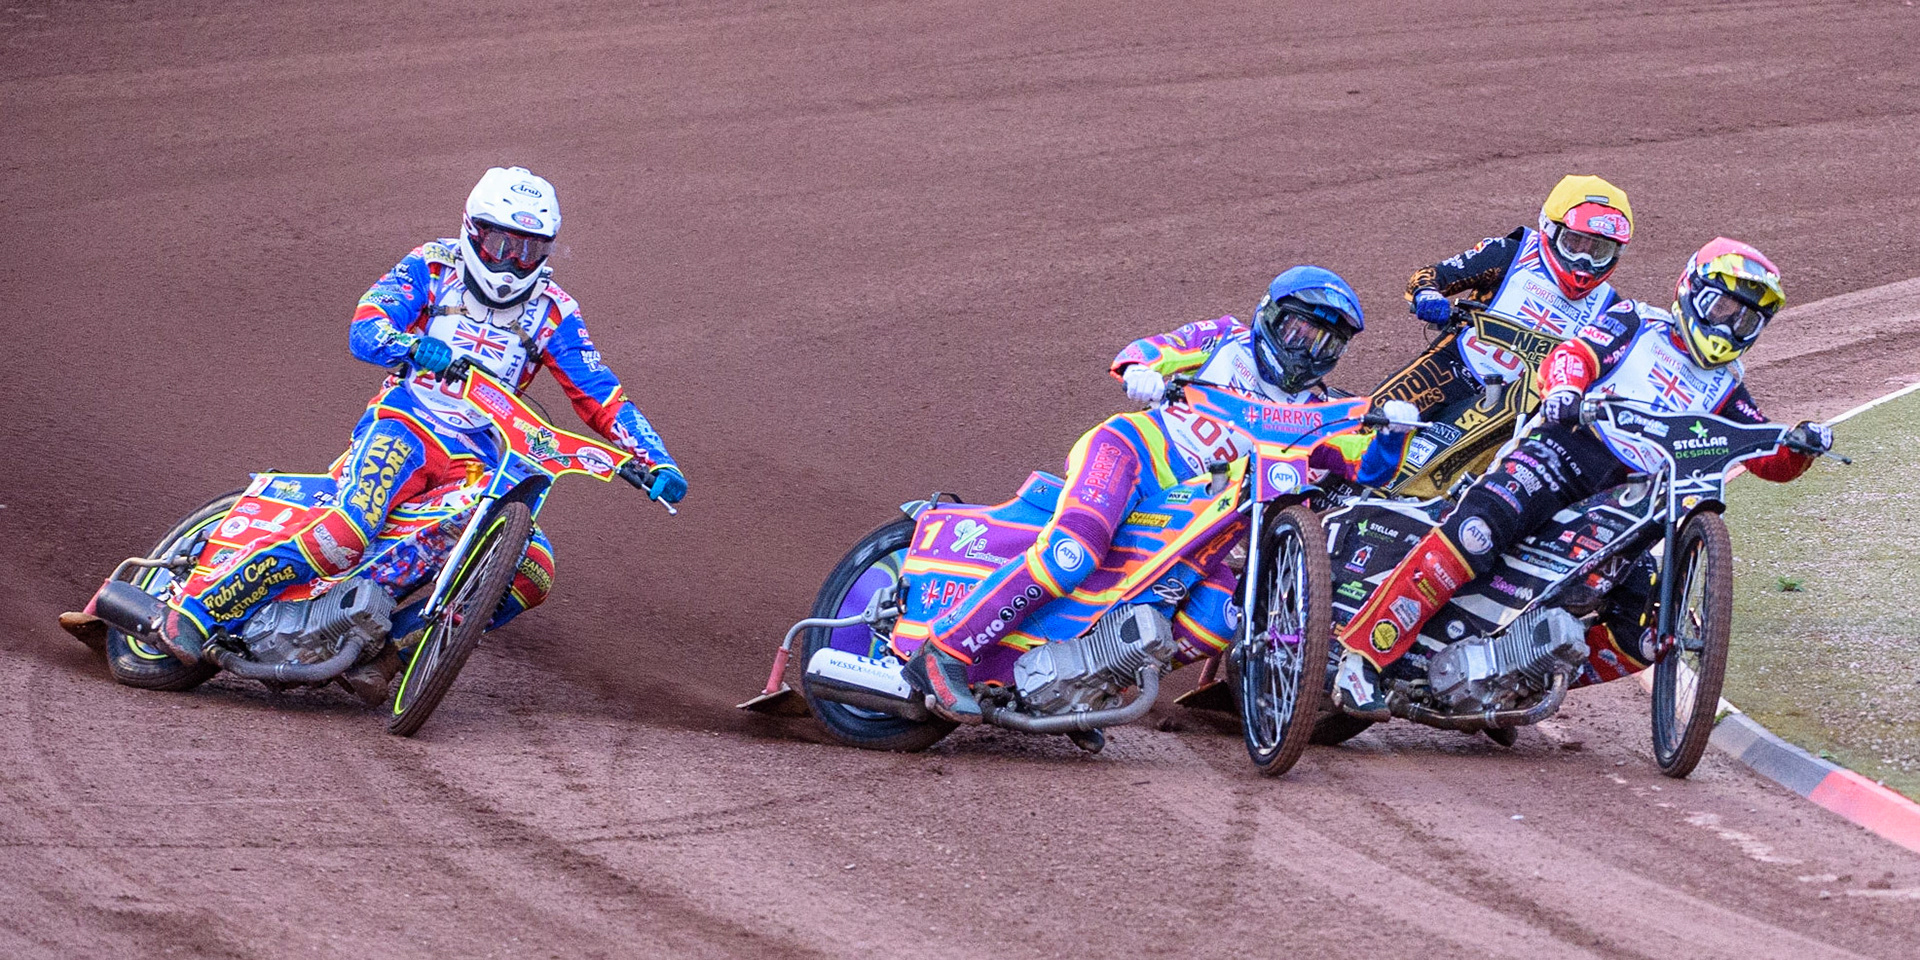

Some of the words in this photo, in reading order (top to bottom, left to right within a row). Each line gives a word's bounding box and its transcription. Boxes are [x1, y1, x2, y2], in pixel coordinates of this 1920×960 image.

[1525, 280, 1556, 304] SPORTS
[1555, 296, 1580, 321] INSURE
[1573, 292, 1599, 335] FINAL
[1234, 357, 1258, 387] SPORTS
[1652, 347, 1682, 370] SPORTS
[1702, 368, 1727, 410] FINAL
[1263, 407, 1323, 428] PARRYS
[1673, 436, 1729, 450] STELLAR
[1675, 447, 1730, 459] DESPATCH
[351, 434, 394, 511] KEVIN
[1085, 443, 1122, 490] PARRYS
[1274, 472, 1294, 483] ATPI
[364, 438, 412, 530] MOORE
[919, 520, 946, 551] 1
[1327, 522, 1341, 554] 1
[1369, 522, 1399, 539] STELLAR
[1467, 525, 1487, 546] ATPI
[1059, 546, 1079, 563] ATPI
[203, 575, 245, 608] Fabri
[244, 556, 277, 583] Can
